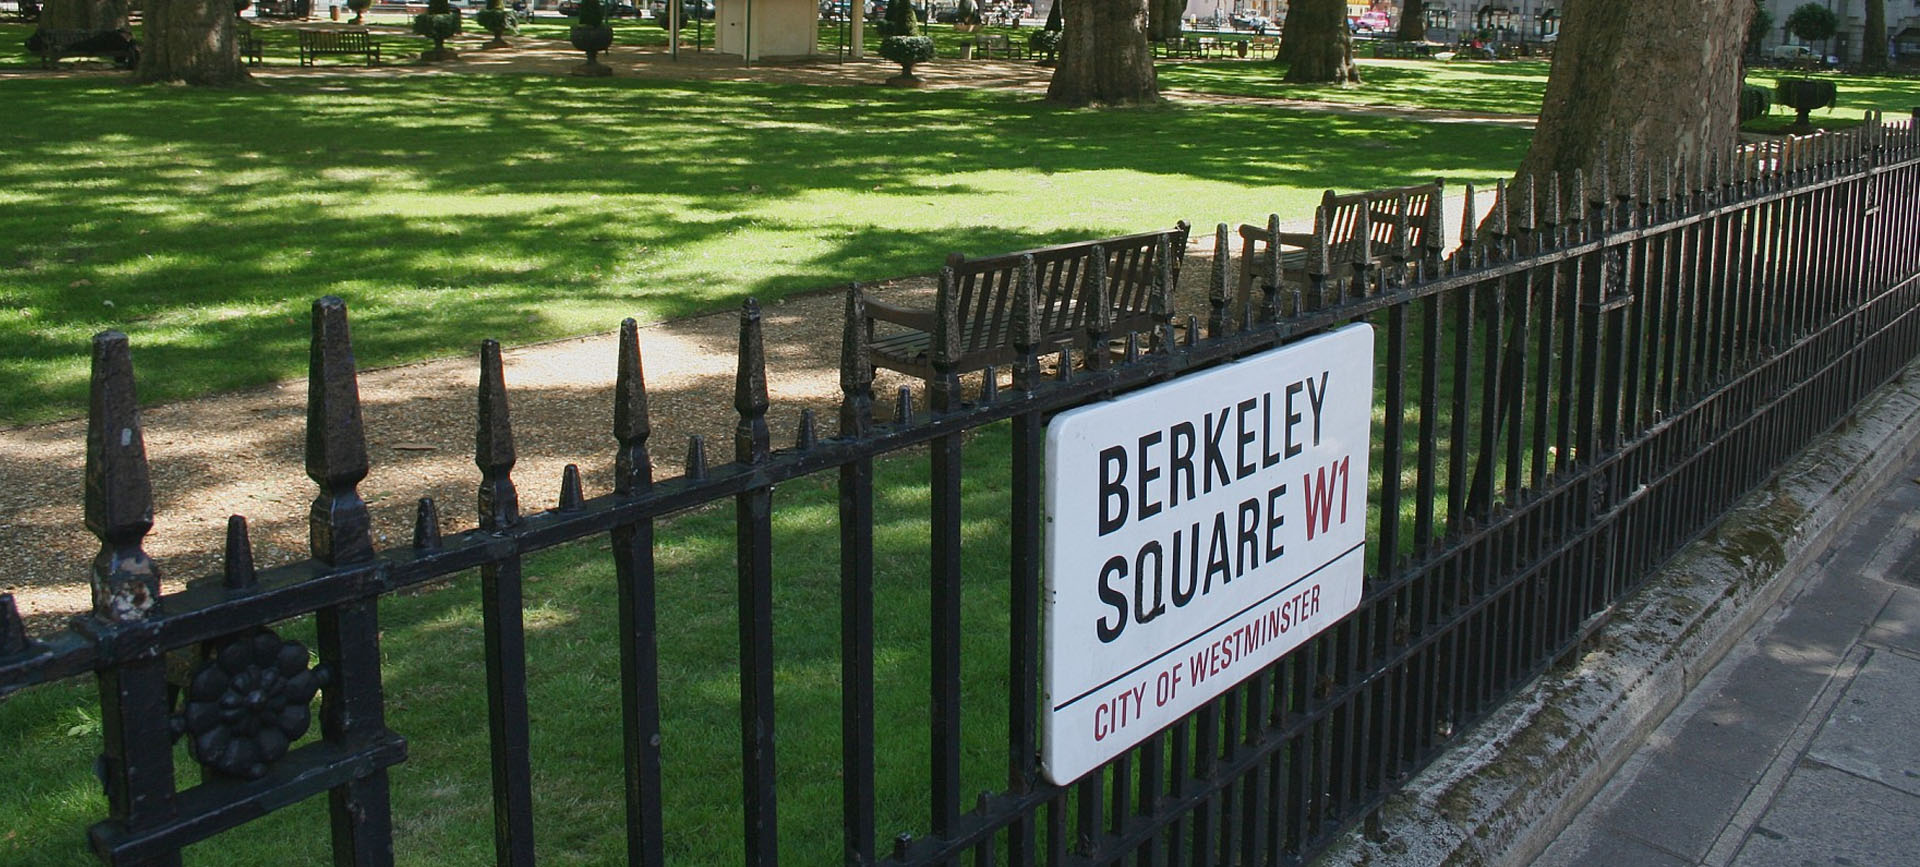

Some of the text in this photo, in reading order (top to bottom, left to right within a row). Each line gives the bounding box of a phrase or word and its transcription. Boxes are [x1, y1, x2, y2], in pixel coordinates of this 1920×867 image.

[1099, 371, 1329, 537] BERKELEY
[1096, 455, 1349, 644] SQUARE W1
[1094, 583, 1321, 742] CITY OF WESTMINSTER
